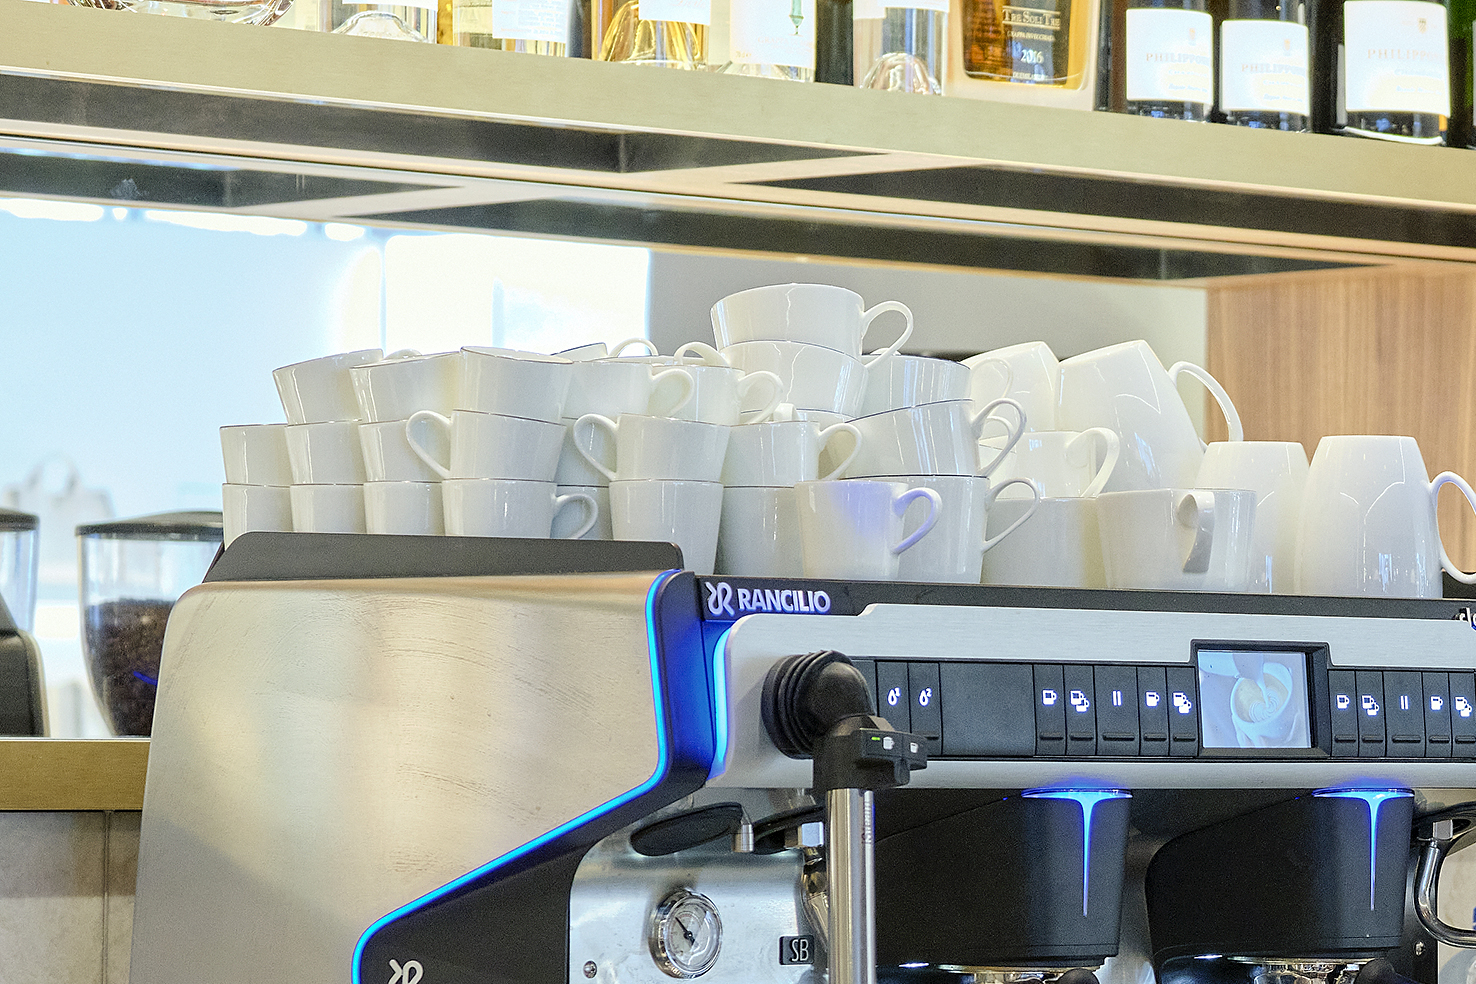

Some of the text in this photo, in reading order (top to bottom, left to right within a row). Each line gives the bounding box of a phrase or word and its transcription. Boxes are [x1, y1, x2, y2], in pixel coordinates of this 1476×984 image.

[1021, 49, 1044, 64] 2016
[737, 588, 831, 614] RANCILIO
[791, 939, 809, 962] SB
